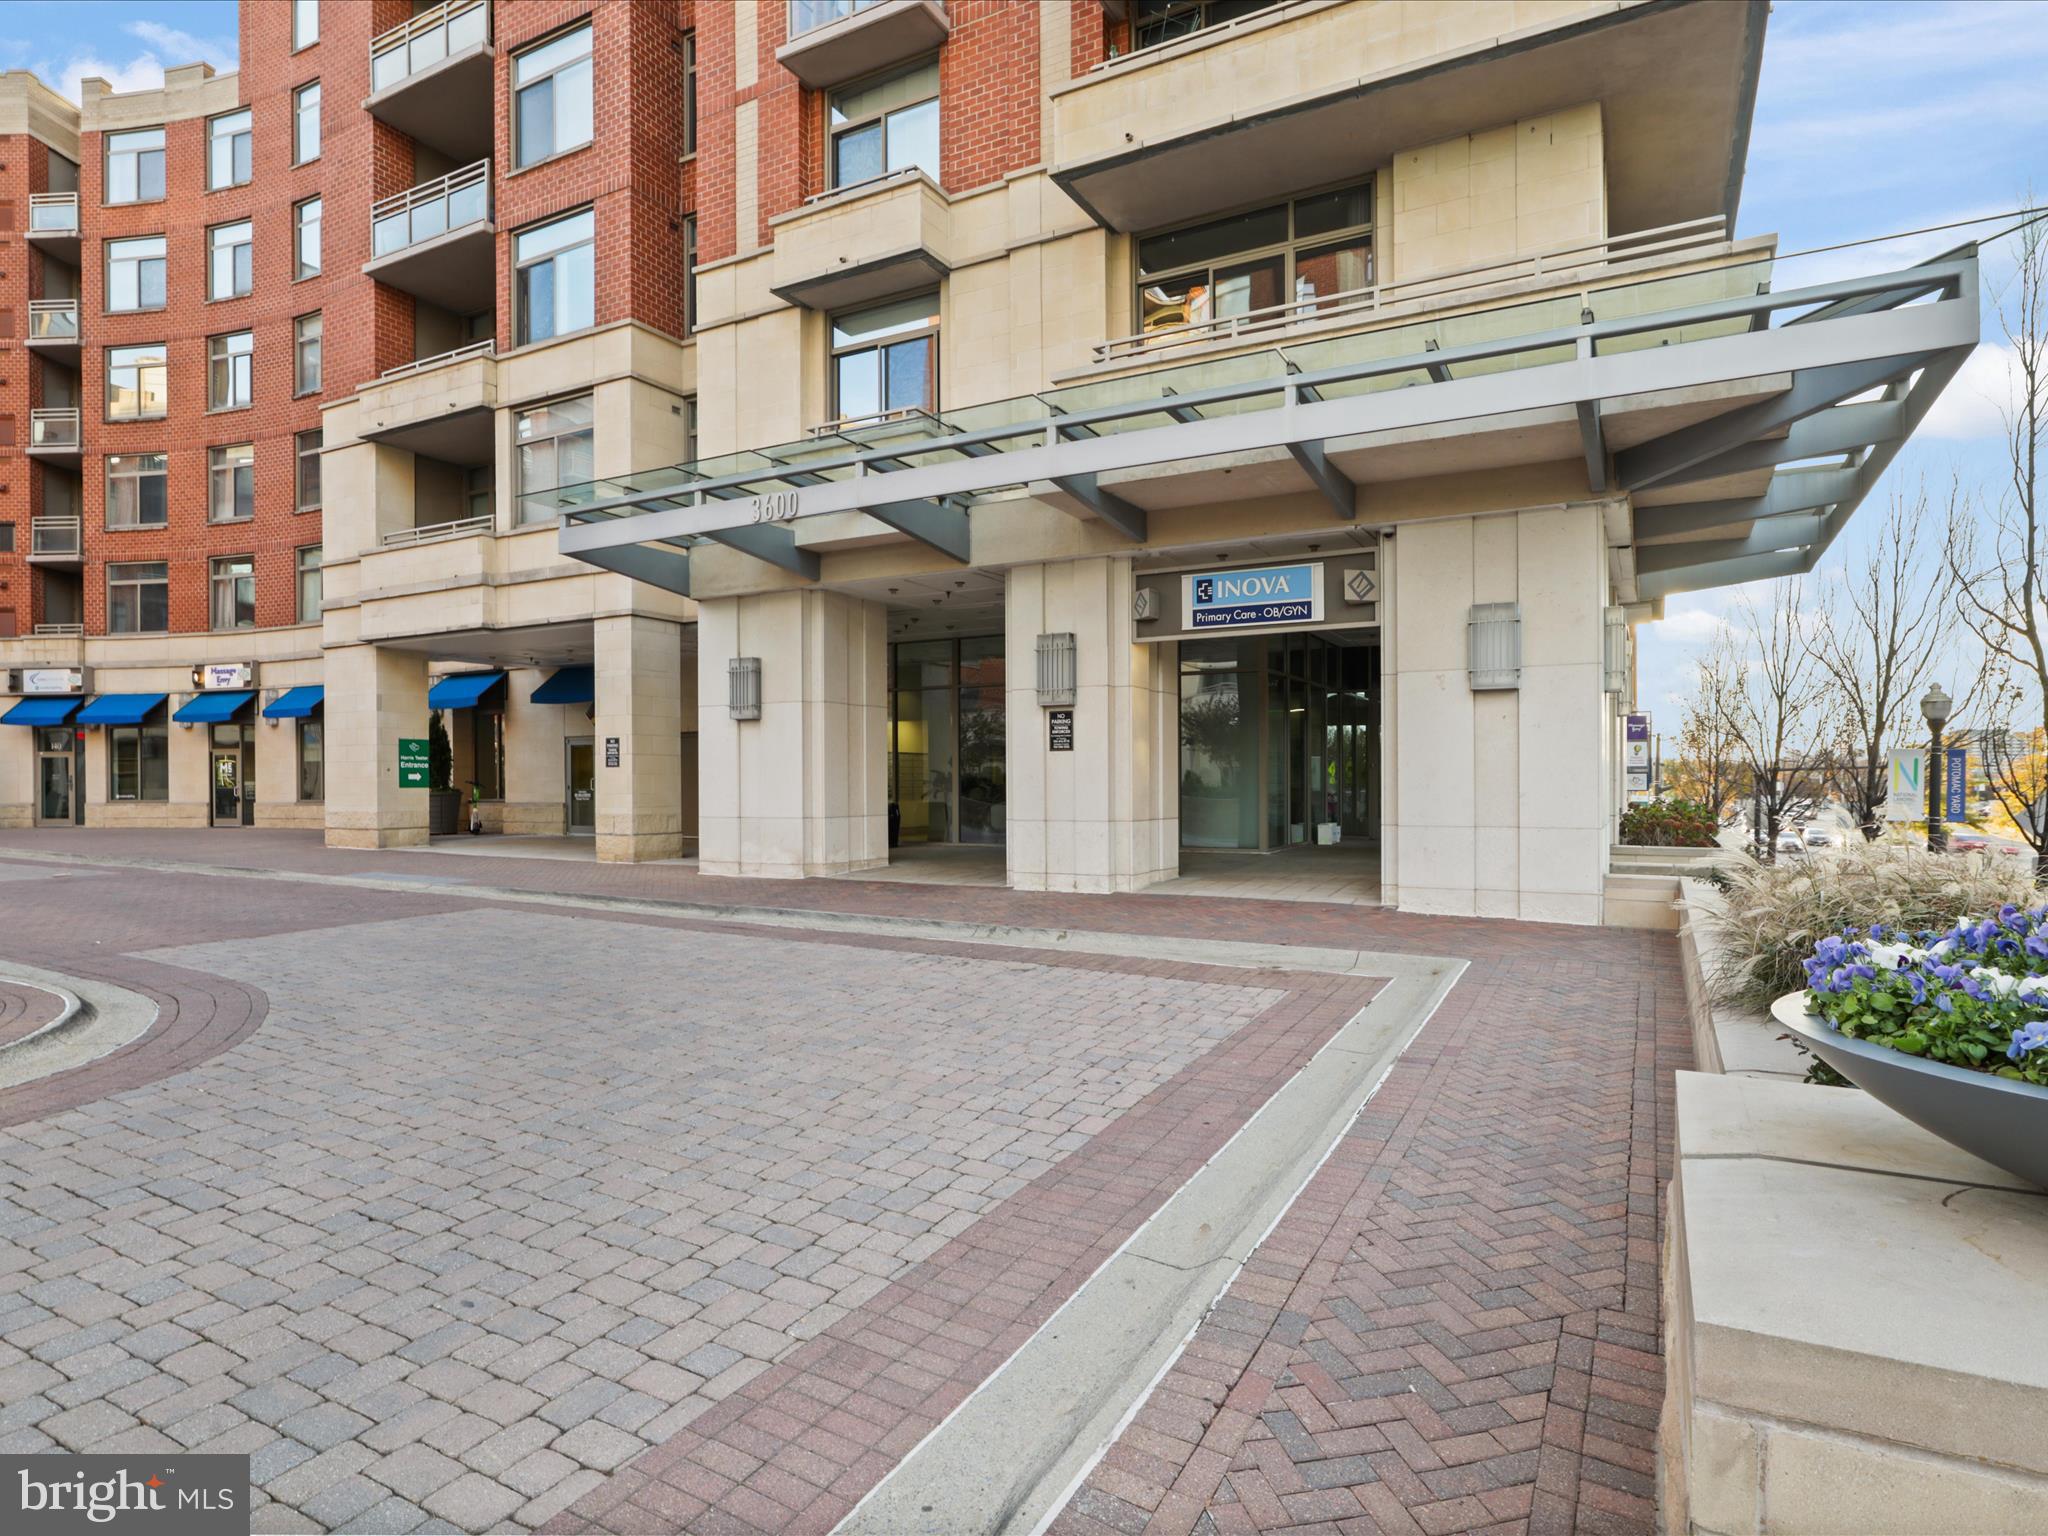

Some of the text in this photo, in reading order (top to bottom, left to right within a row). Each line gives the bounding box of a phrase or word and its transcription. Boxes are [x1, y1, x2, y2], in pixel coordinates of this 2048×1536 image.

[752, 491, 799, 524] 3600
[1217, 575, 1290, 598] INOVA
[1196, 612, 1231, 623] Primary
[1233, 609, 1256, 620] Care
[1263, 605, 1308, 619] OB/GYN
[210, 667, 237, 677] Massage
[216, 675, 231, 686] Envy
[400, 761, 429, 769] Entrance
[1950, 757, 1962, 814] POTOMAC YARD
